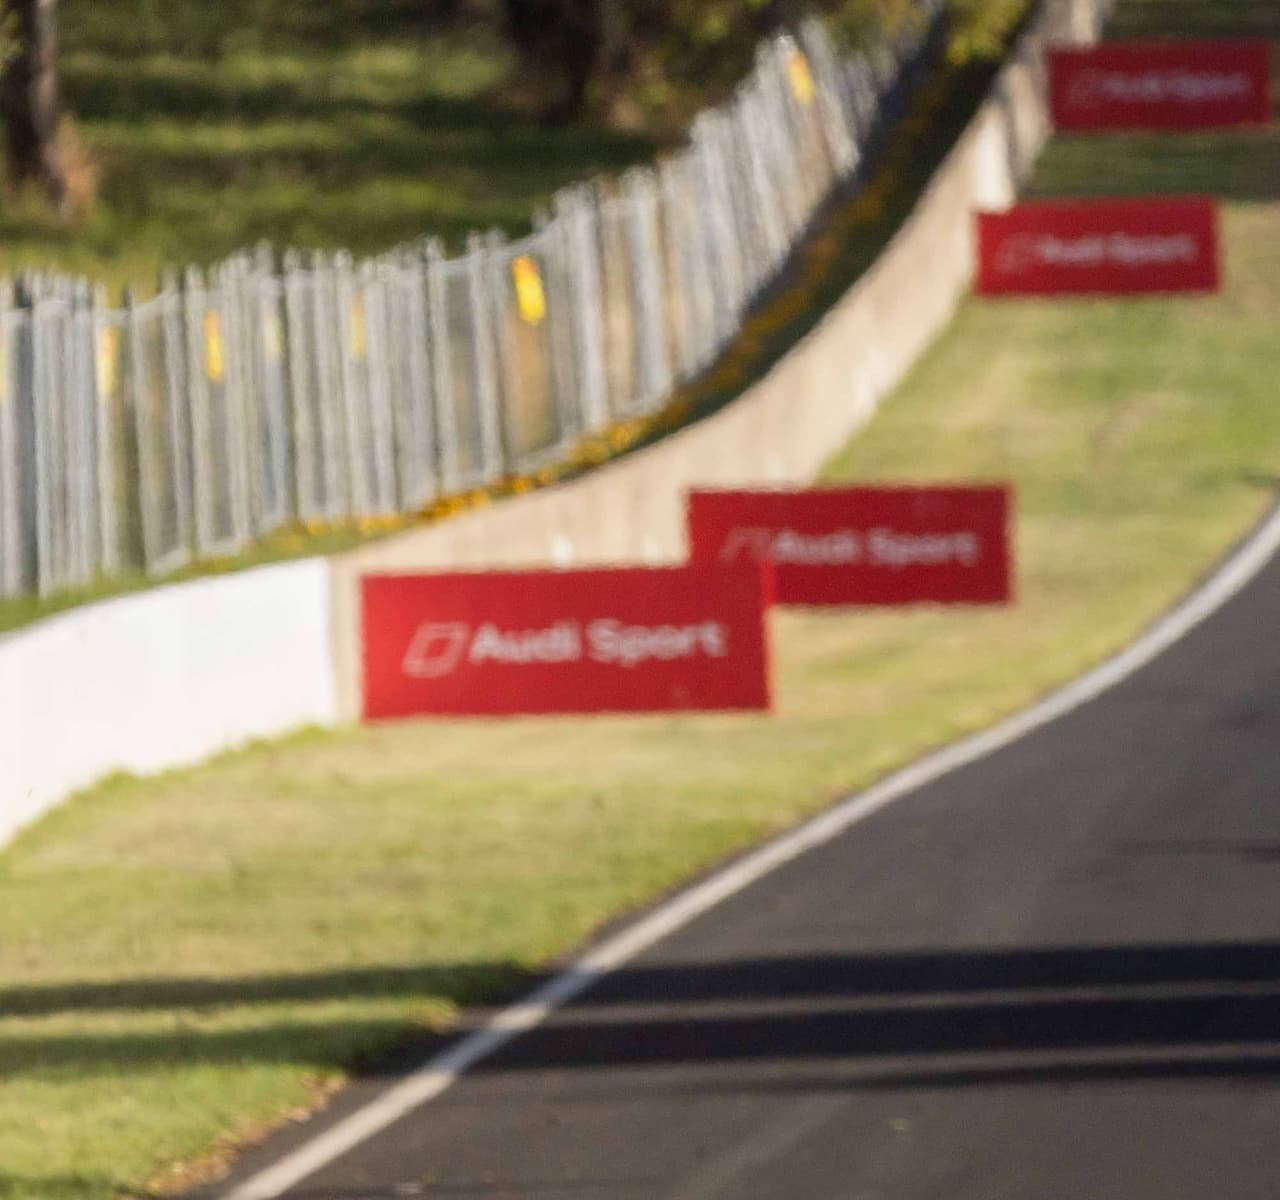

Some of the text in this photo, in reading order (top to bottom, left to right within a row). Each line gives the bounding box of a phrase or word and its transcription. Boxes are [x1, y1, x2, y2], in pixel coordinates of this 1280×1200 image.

[773, 527, 980, 569] Audi Sport
[470, 619, 727, 668] Audi Sport
